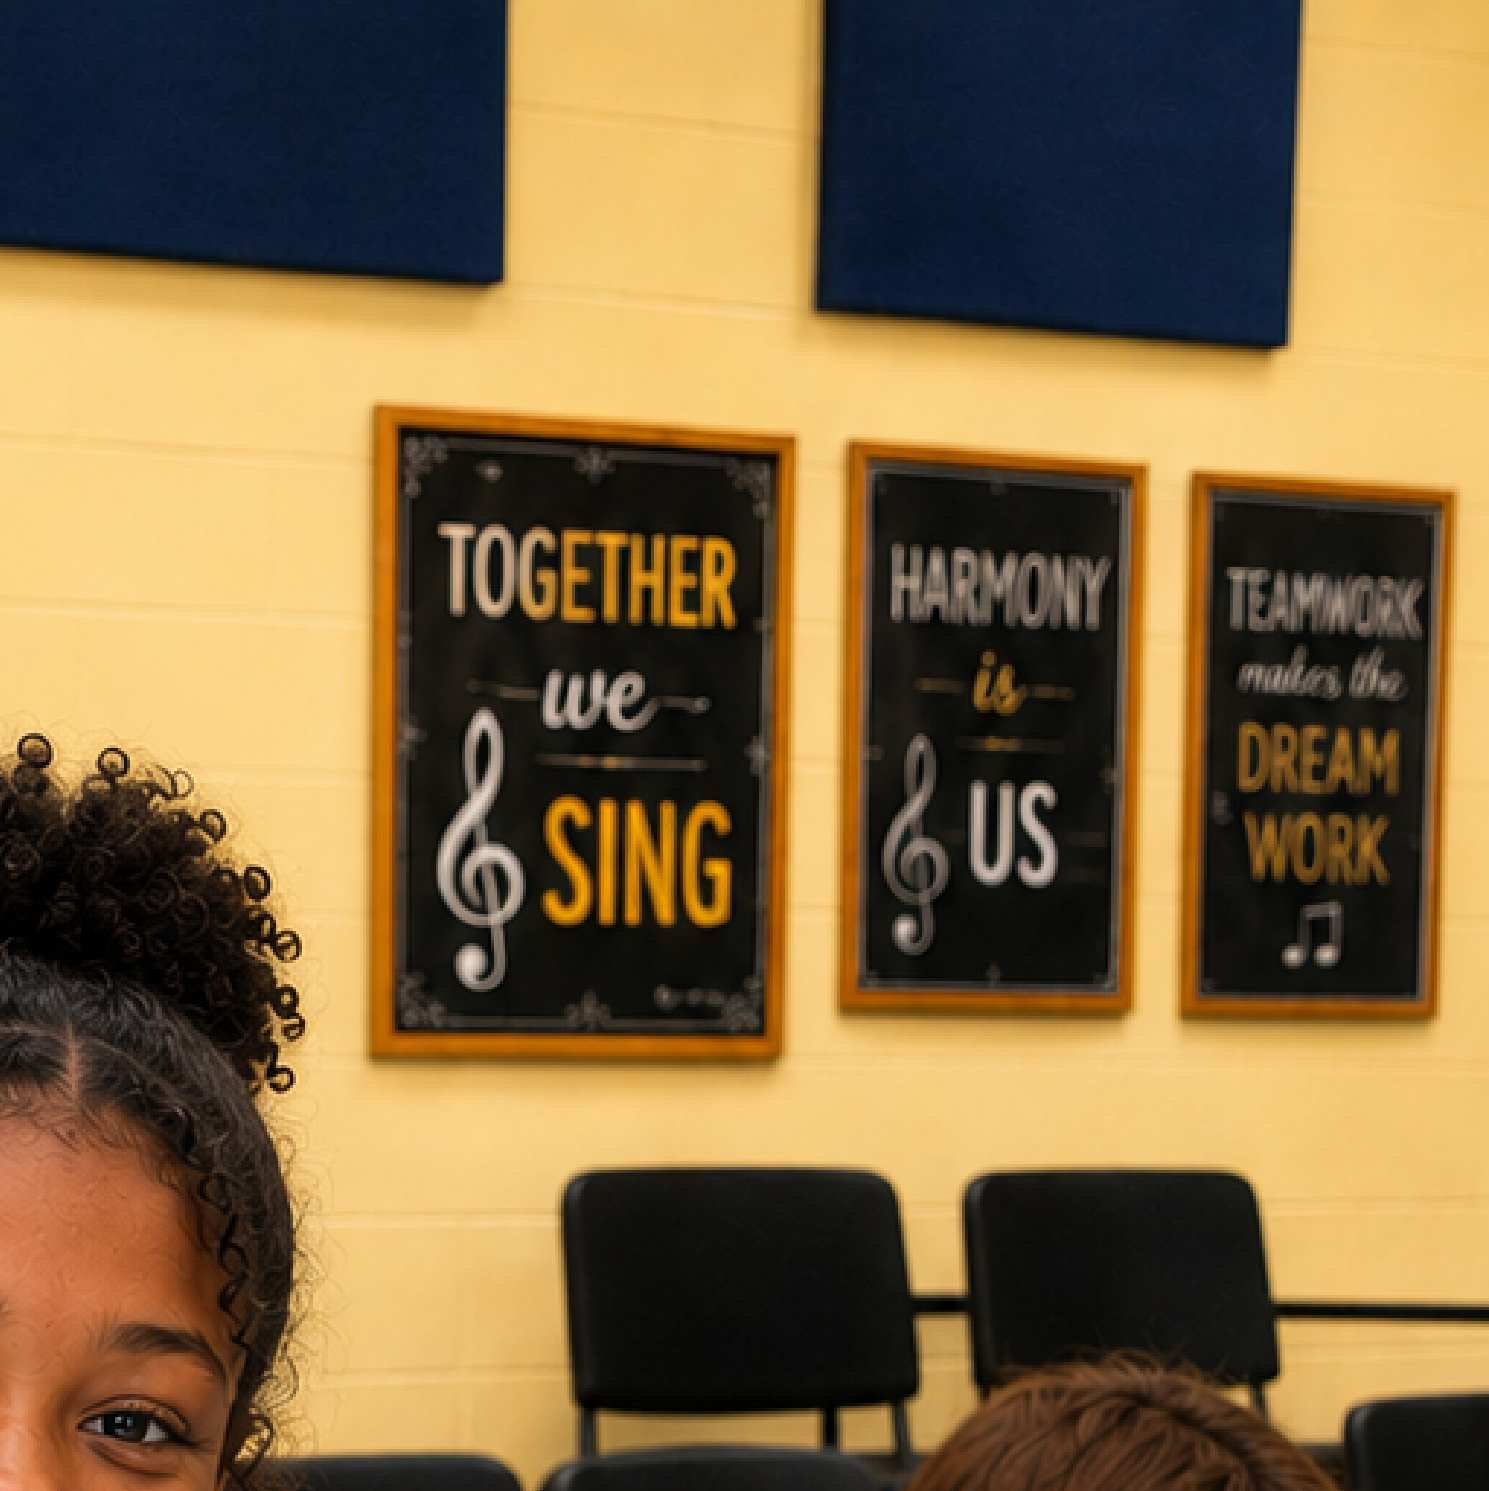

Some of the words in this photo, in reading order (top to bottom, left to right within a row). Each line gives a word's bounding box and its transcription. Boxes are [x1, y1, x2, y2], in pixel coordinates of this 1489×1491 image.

[437, 522, 737, 630] TOGETHER
[889, 541, 1112, 631] HARMONY
[1225, 566, 1424, 641] TEAMWORK
[542, 669, 660, 733] we
[973, 649, 1025, 716] is
[1349, 644, 1408, 700] the
[1236, 719, 1400, 795] DREAM
[541, 795, 733, 928] SING
[968, 779, 1059, 889] US
[1243, 811, 1390, 885] WORK
